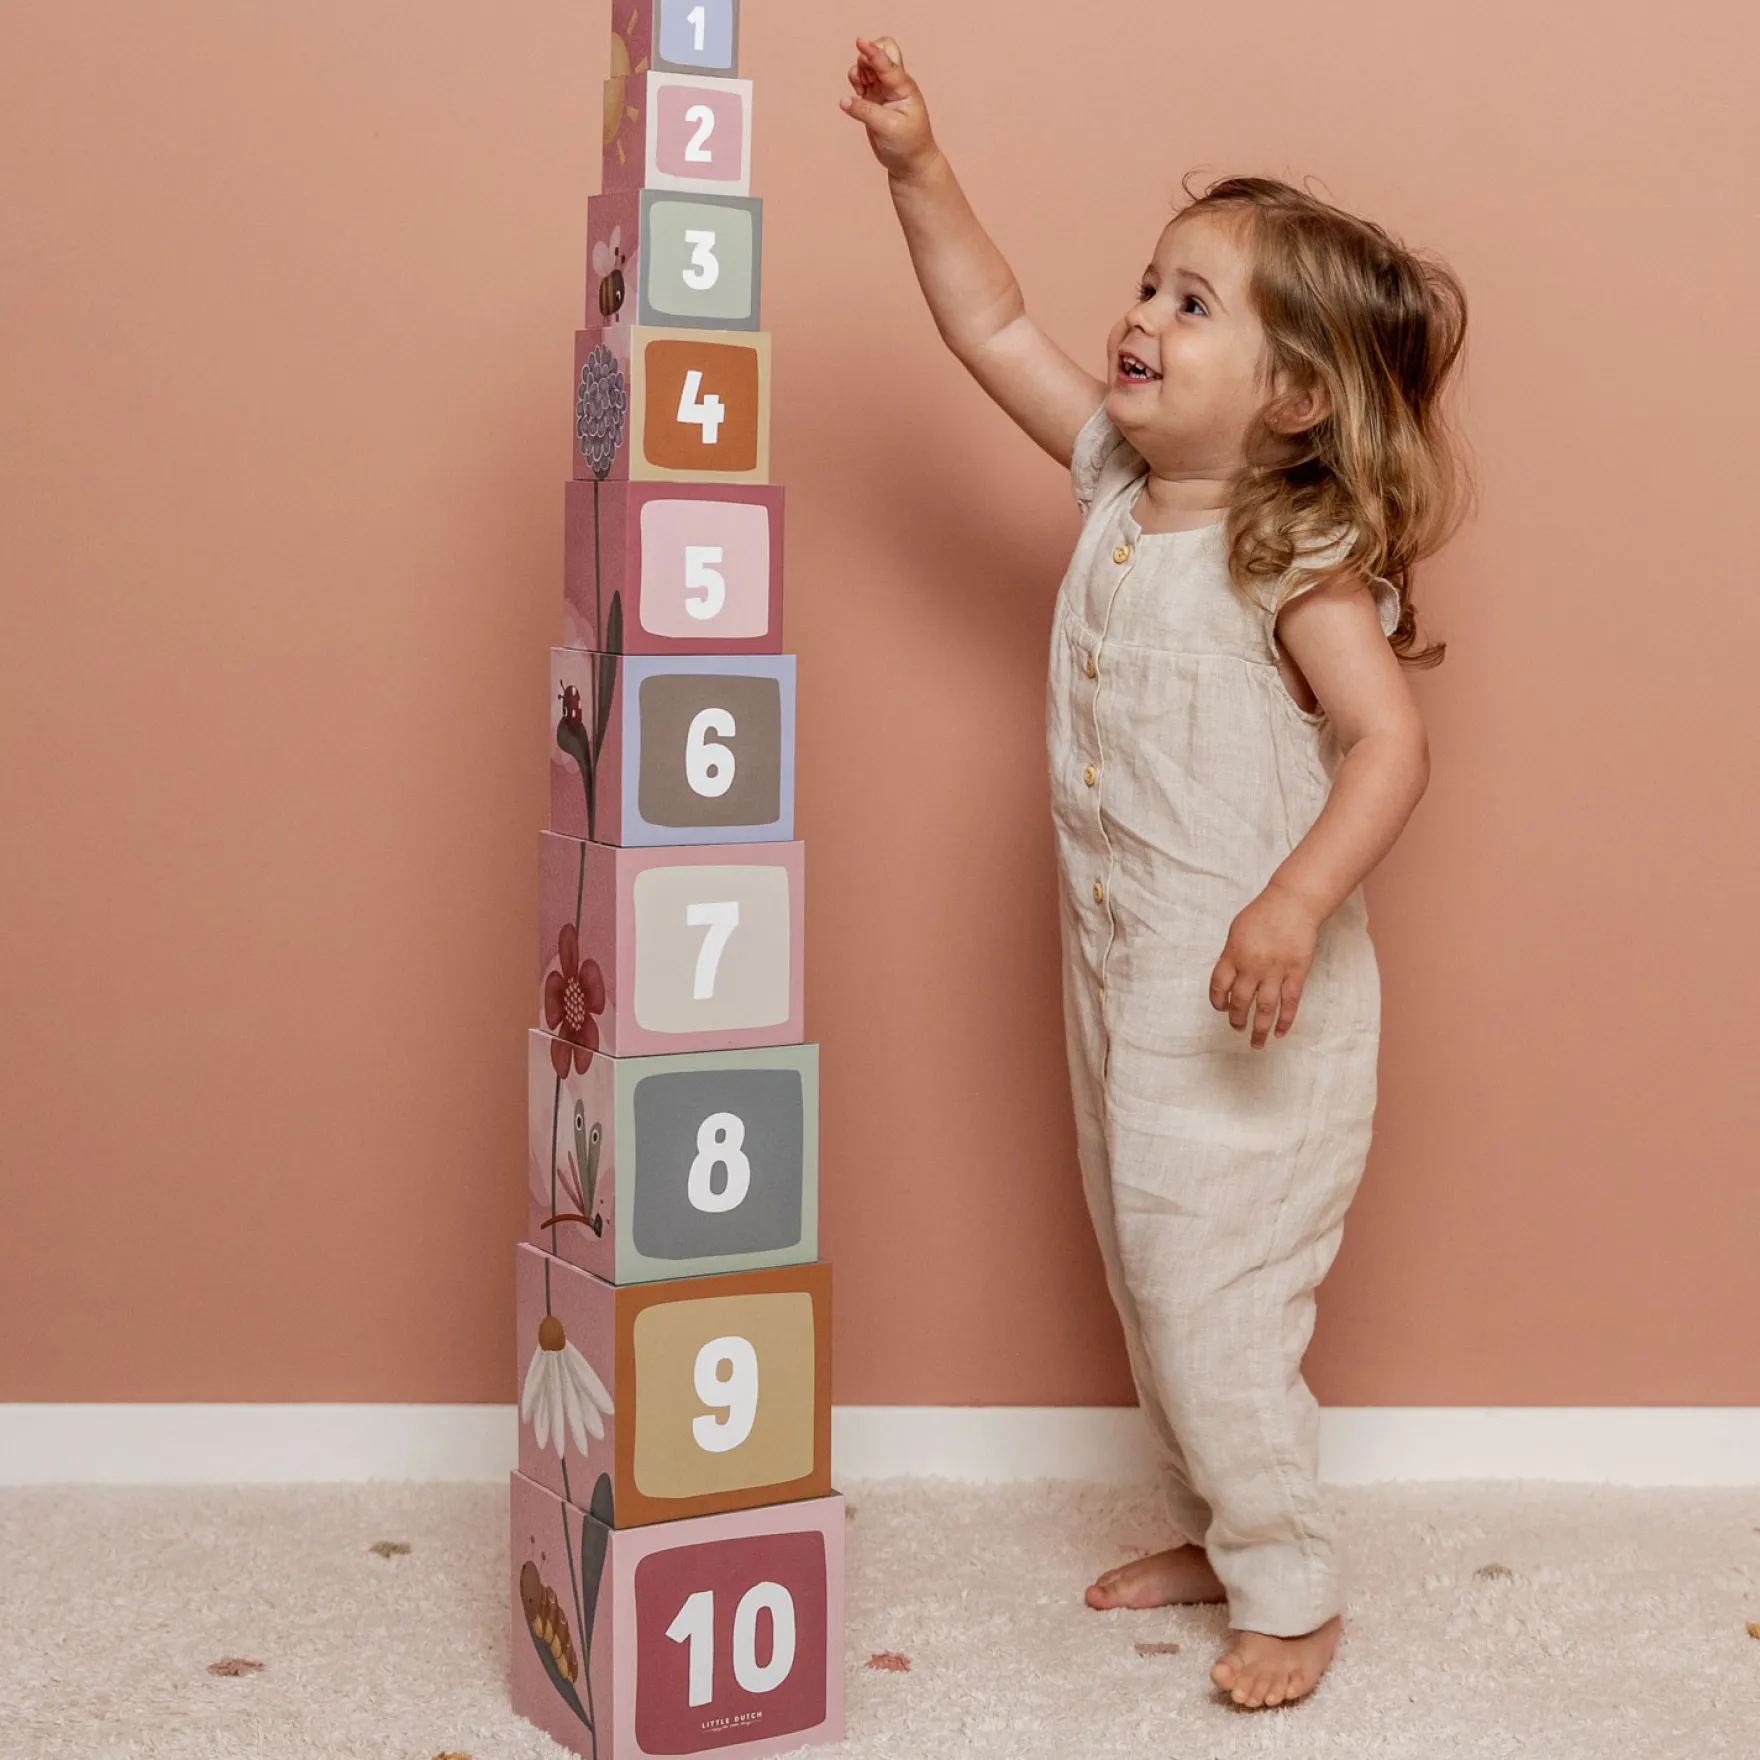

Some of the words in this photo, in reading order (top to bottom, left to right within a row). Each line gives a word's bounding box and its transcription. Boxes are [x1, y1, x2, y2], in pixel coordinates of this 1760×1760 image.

[687, 6, 704, 51] 1
[685, 104, 715, 162] 2
[682, 230, 719, 290] 3
[676, 371, 725, 444] 4
[683, 546, 726, 621] 5
[685, 708, 736, 797] 6
[686, 901, 740, 1000] 7
[687, 1112, 751, 1213] 8
[692, 1336, 759, 1453] 9
[666, 1581, 796, 1706] 10
[701, 1717, 730, 1729] LITTLE
[734, 1711, 763, 1723] DUTCH
